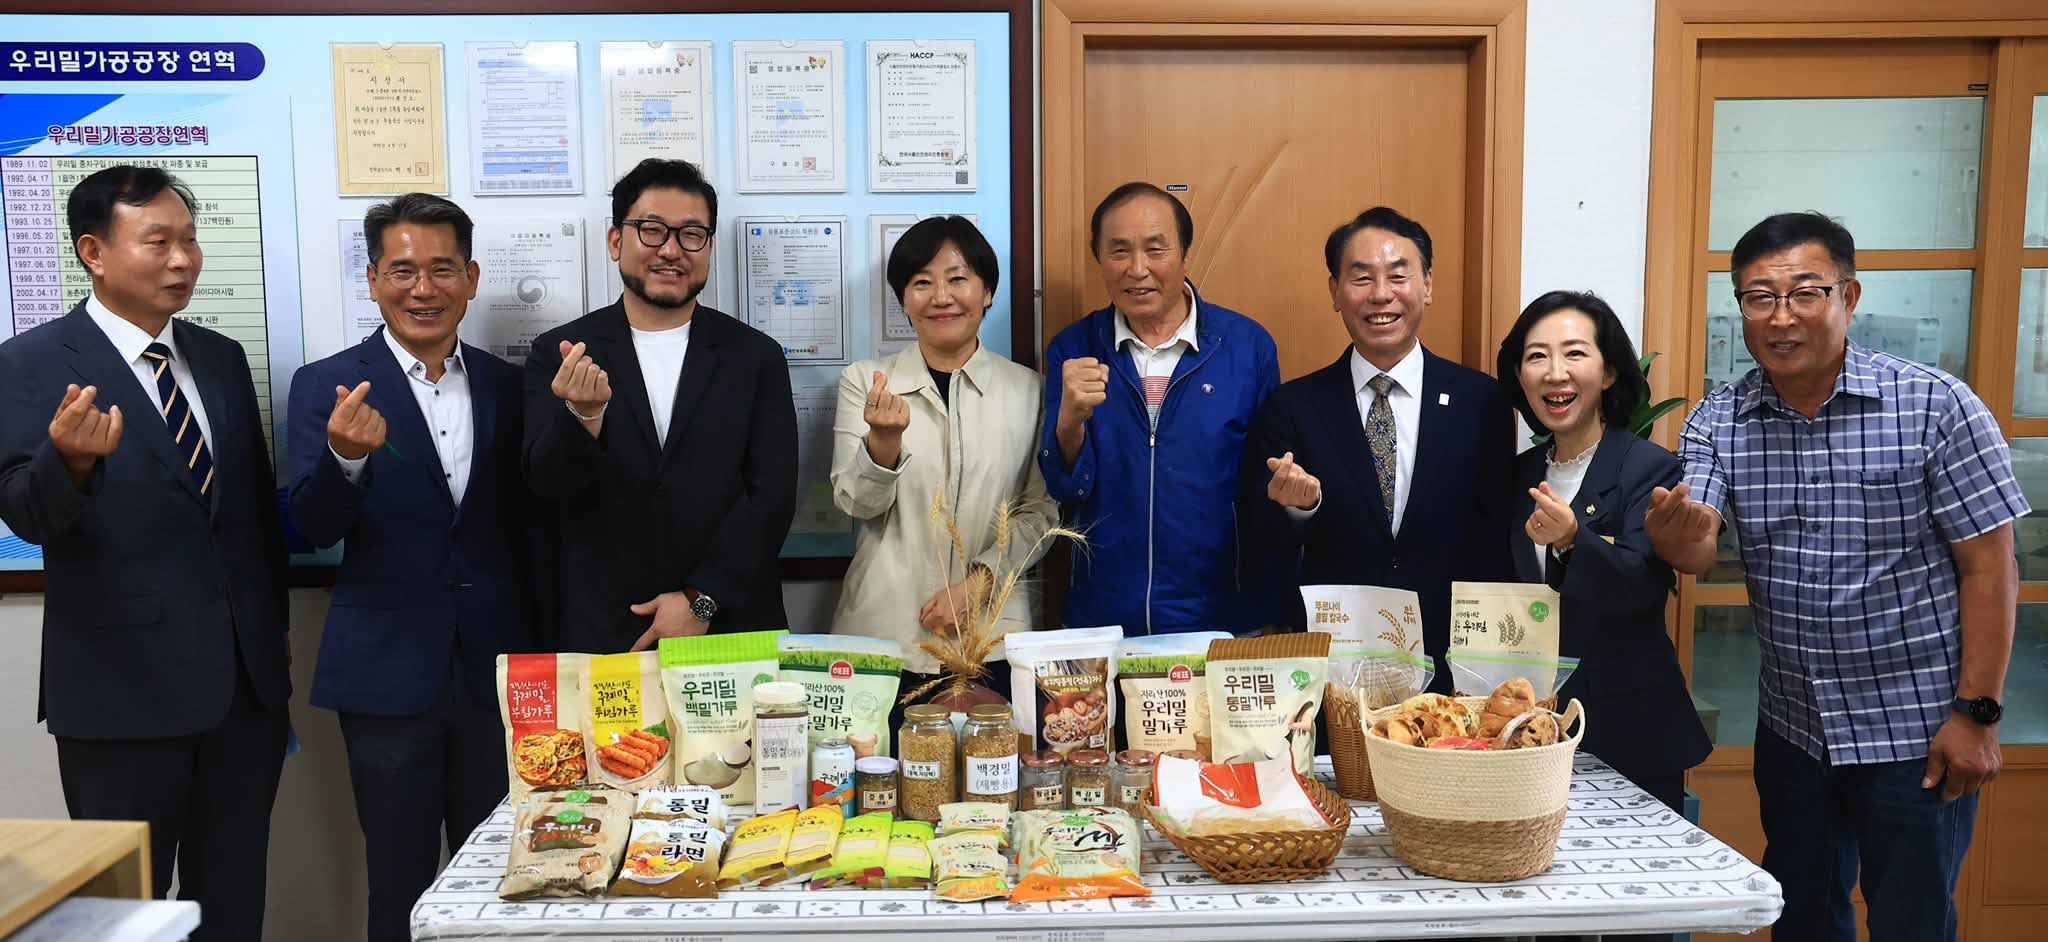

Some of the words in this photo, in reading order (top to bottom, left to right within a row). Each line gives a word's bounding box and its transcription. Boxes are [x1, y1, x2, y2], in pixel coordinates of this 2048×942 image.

[9, 49, 180, 74] 우리밀가공공장
[189, 49, 236, 73] 연혁
[48, 125, 209, 146] 우리밀가공공장연혁
[681, 678, 737, 700] 우리밀
[1223, 673, 1275, 695] 우리밀
[511, 704, 553, 719] 부침가루
[595, 704, 638, 719] 튀김가루
[685, 700, 738, 717] 백밀가루
[1141, 699, 1187, 718] 우리밀
[1226, 695, 1277, 712] 통밀가루
[807, 714, 853, 732] 밀가루
[1142, 718, 1188, 736] 밀가루
[666, 797, 710, 815] 통밀
[661, 844, 705, 861] 라면
